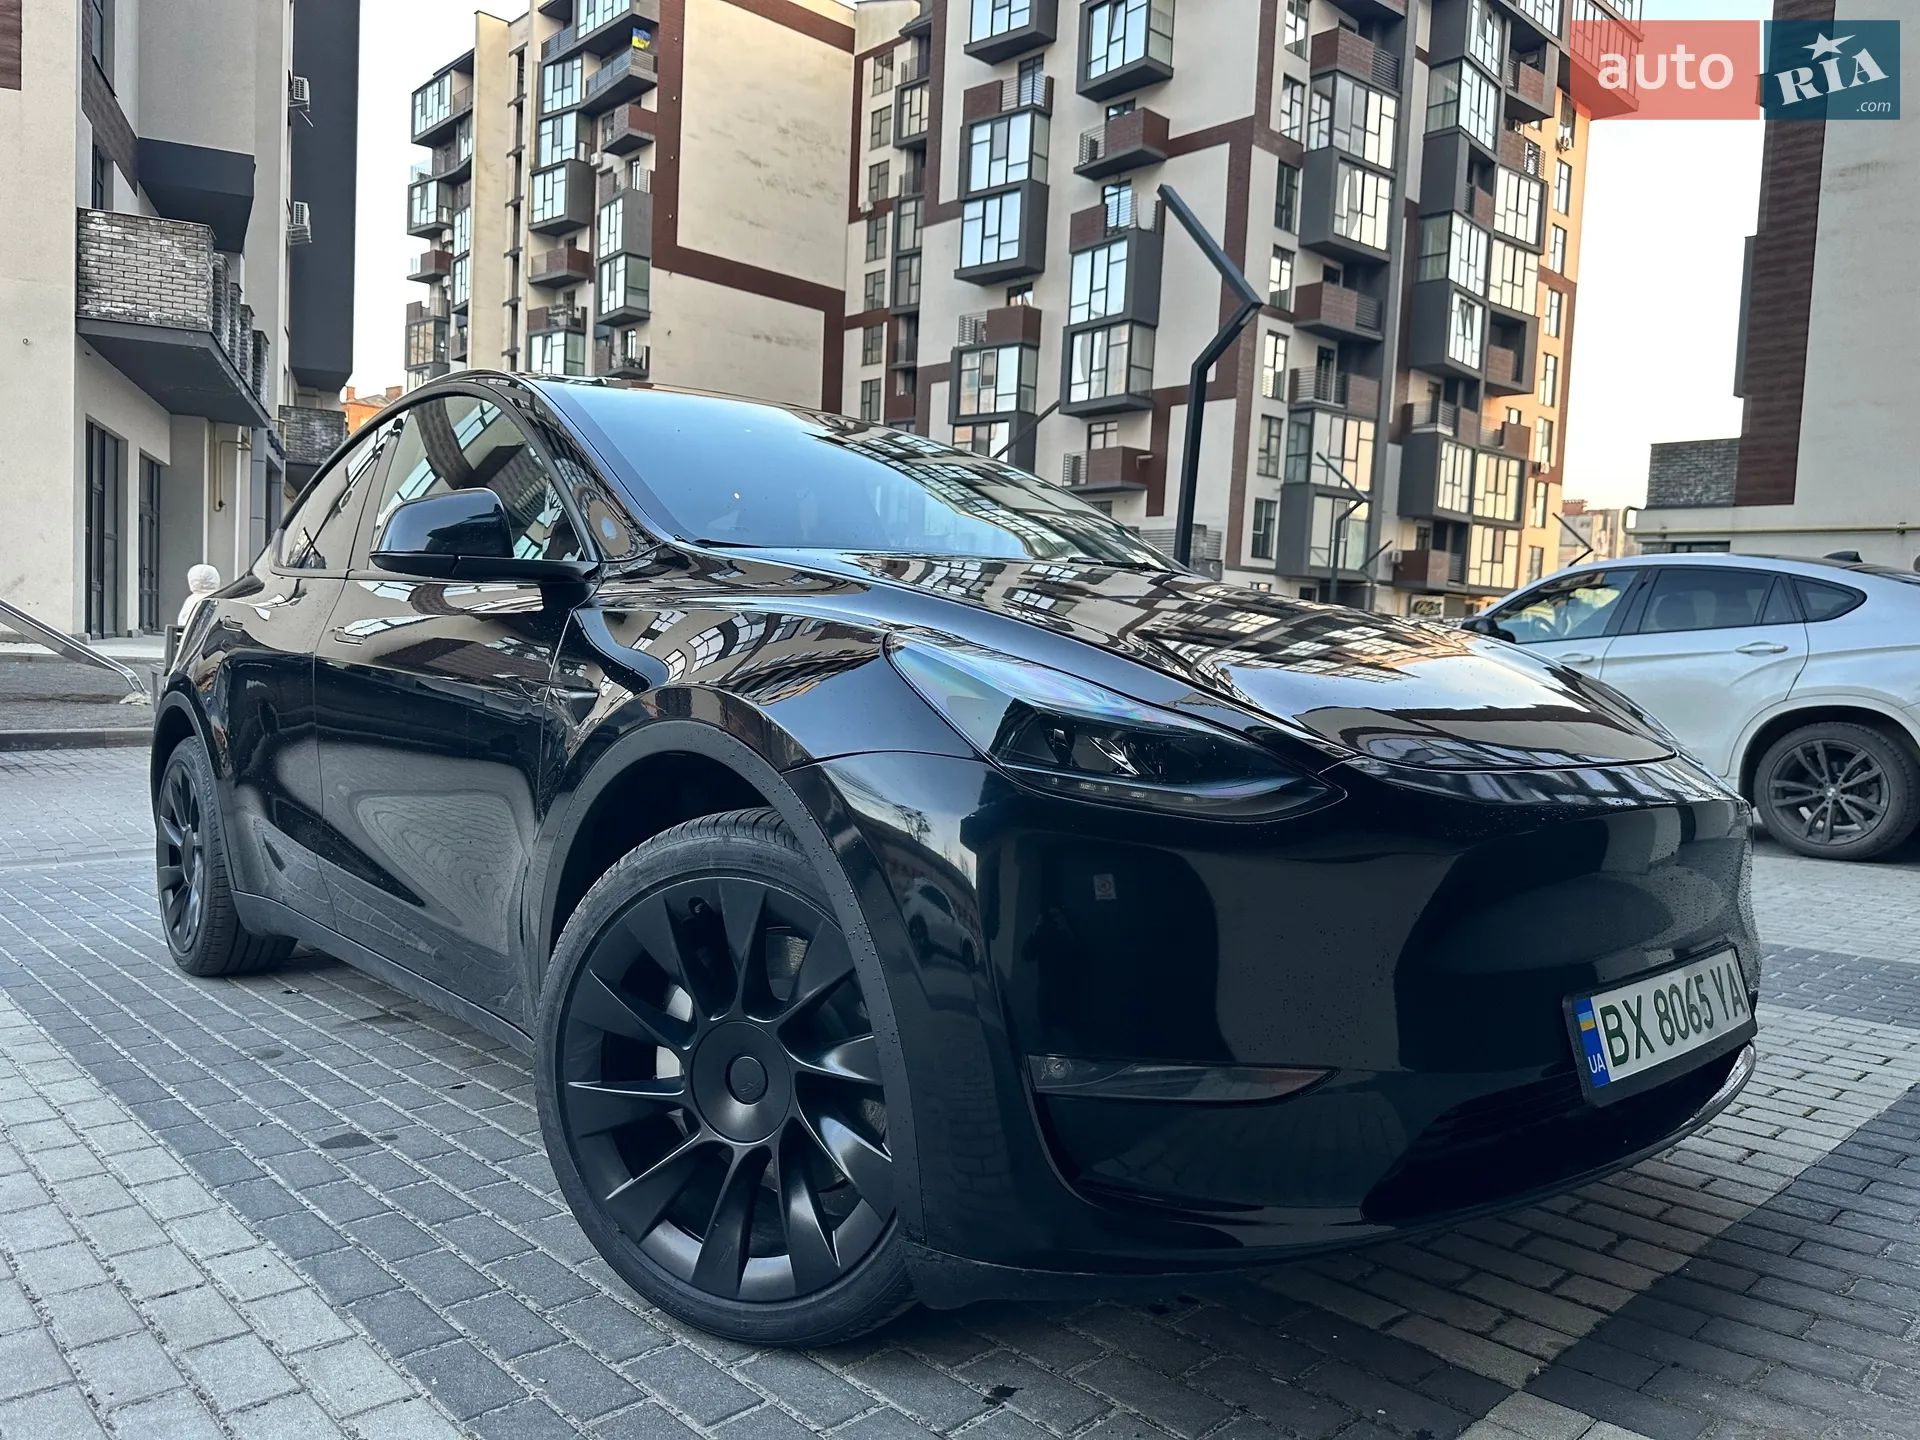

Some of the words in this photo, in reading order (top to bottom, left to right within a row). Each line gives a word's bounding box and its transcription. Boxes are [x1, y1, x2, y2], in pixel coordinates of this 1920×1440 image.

[1599, 994, 1655, 1068] BX
[1653, 973, 1714, 1046] 8065
[1710, 963, 1746, 1021] YA
[1588, 1053, 1606, 1074] UA
